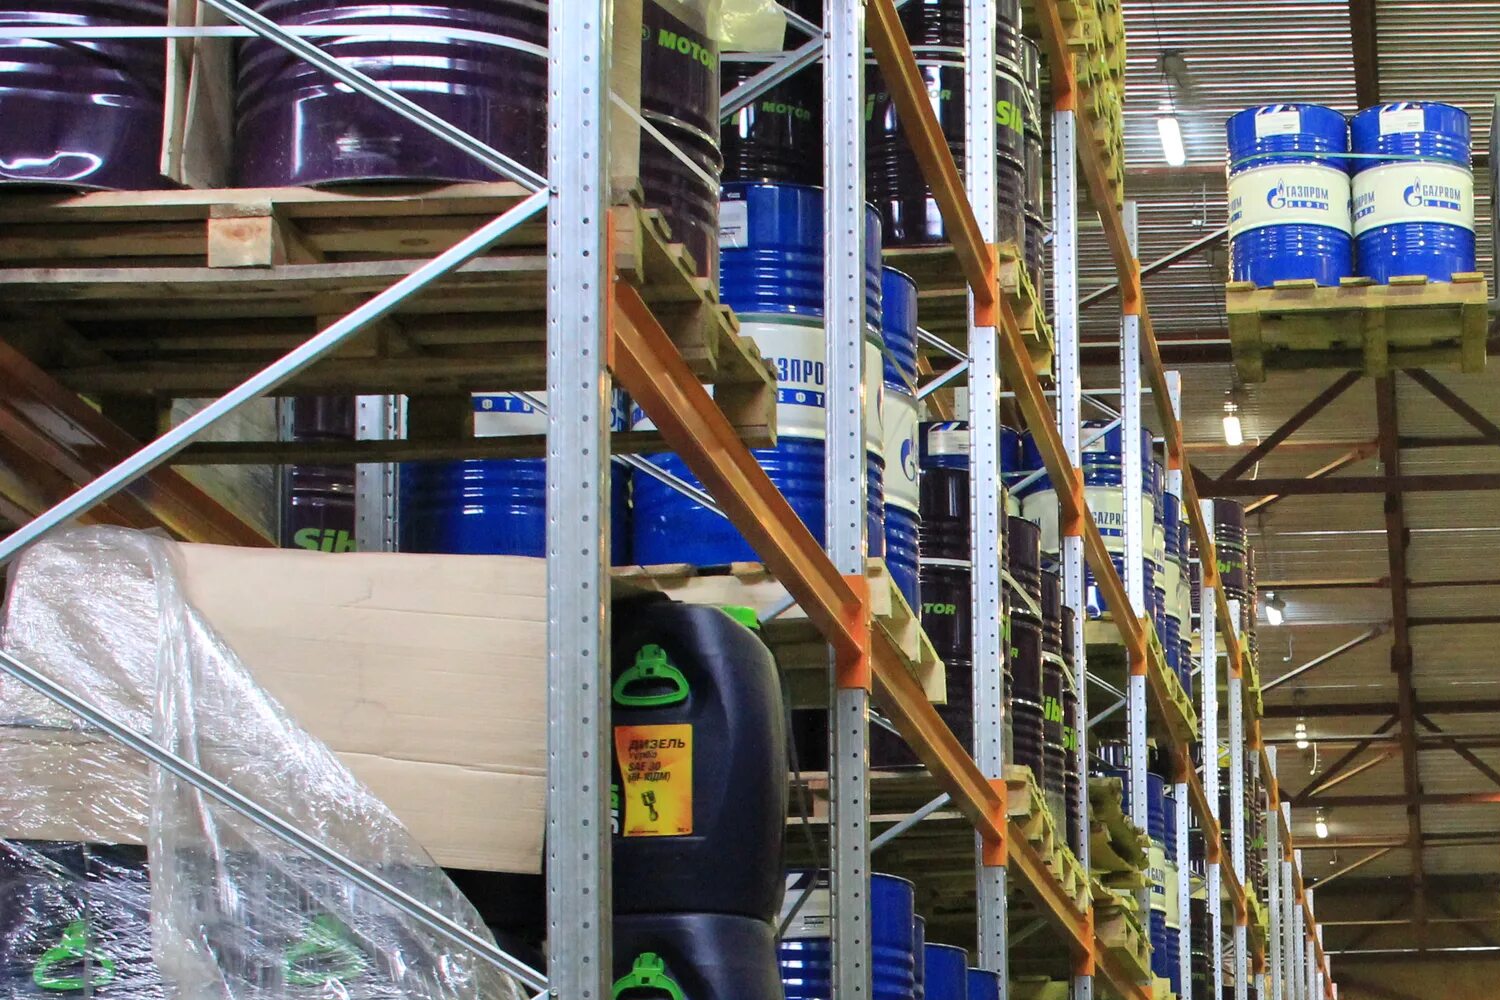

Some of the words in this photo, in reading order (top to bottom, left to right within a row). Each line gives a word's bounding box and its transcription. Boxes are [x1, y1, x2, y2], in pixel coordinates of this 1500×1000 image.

[1286, 186, 1329, 200] ГАЗПРОМ
[1422, 185, 1462, 200] GAZPROM
[777, 359, 825, 386] ЗПРО
[924, 603, 956, 616] TOR
[628, 739, 686, 751] ДИЗЕЛЬ
